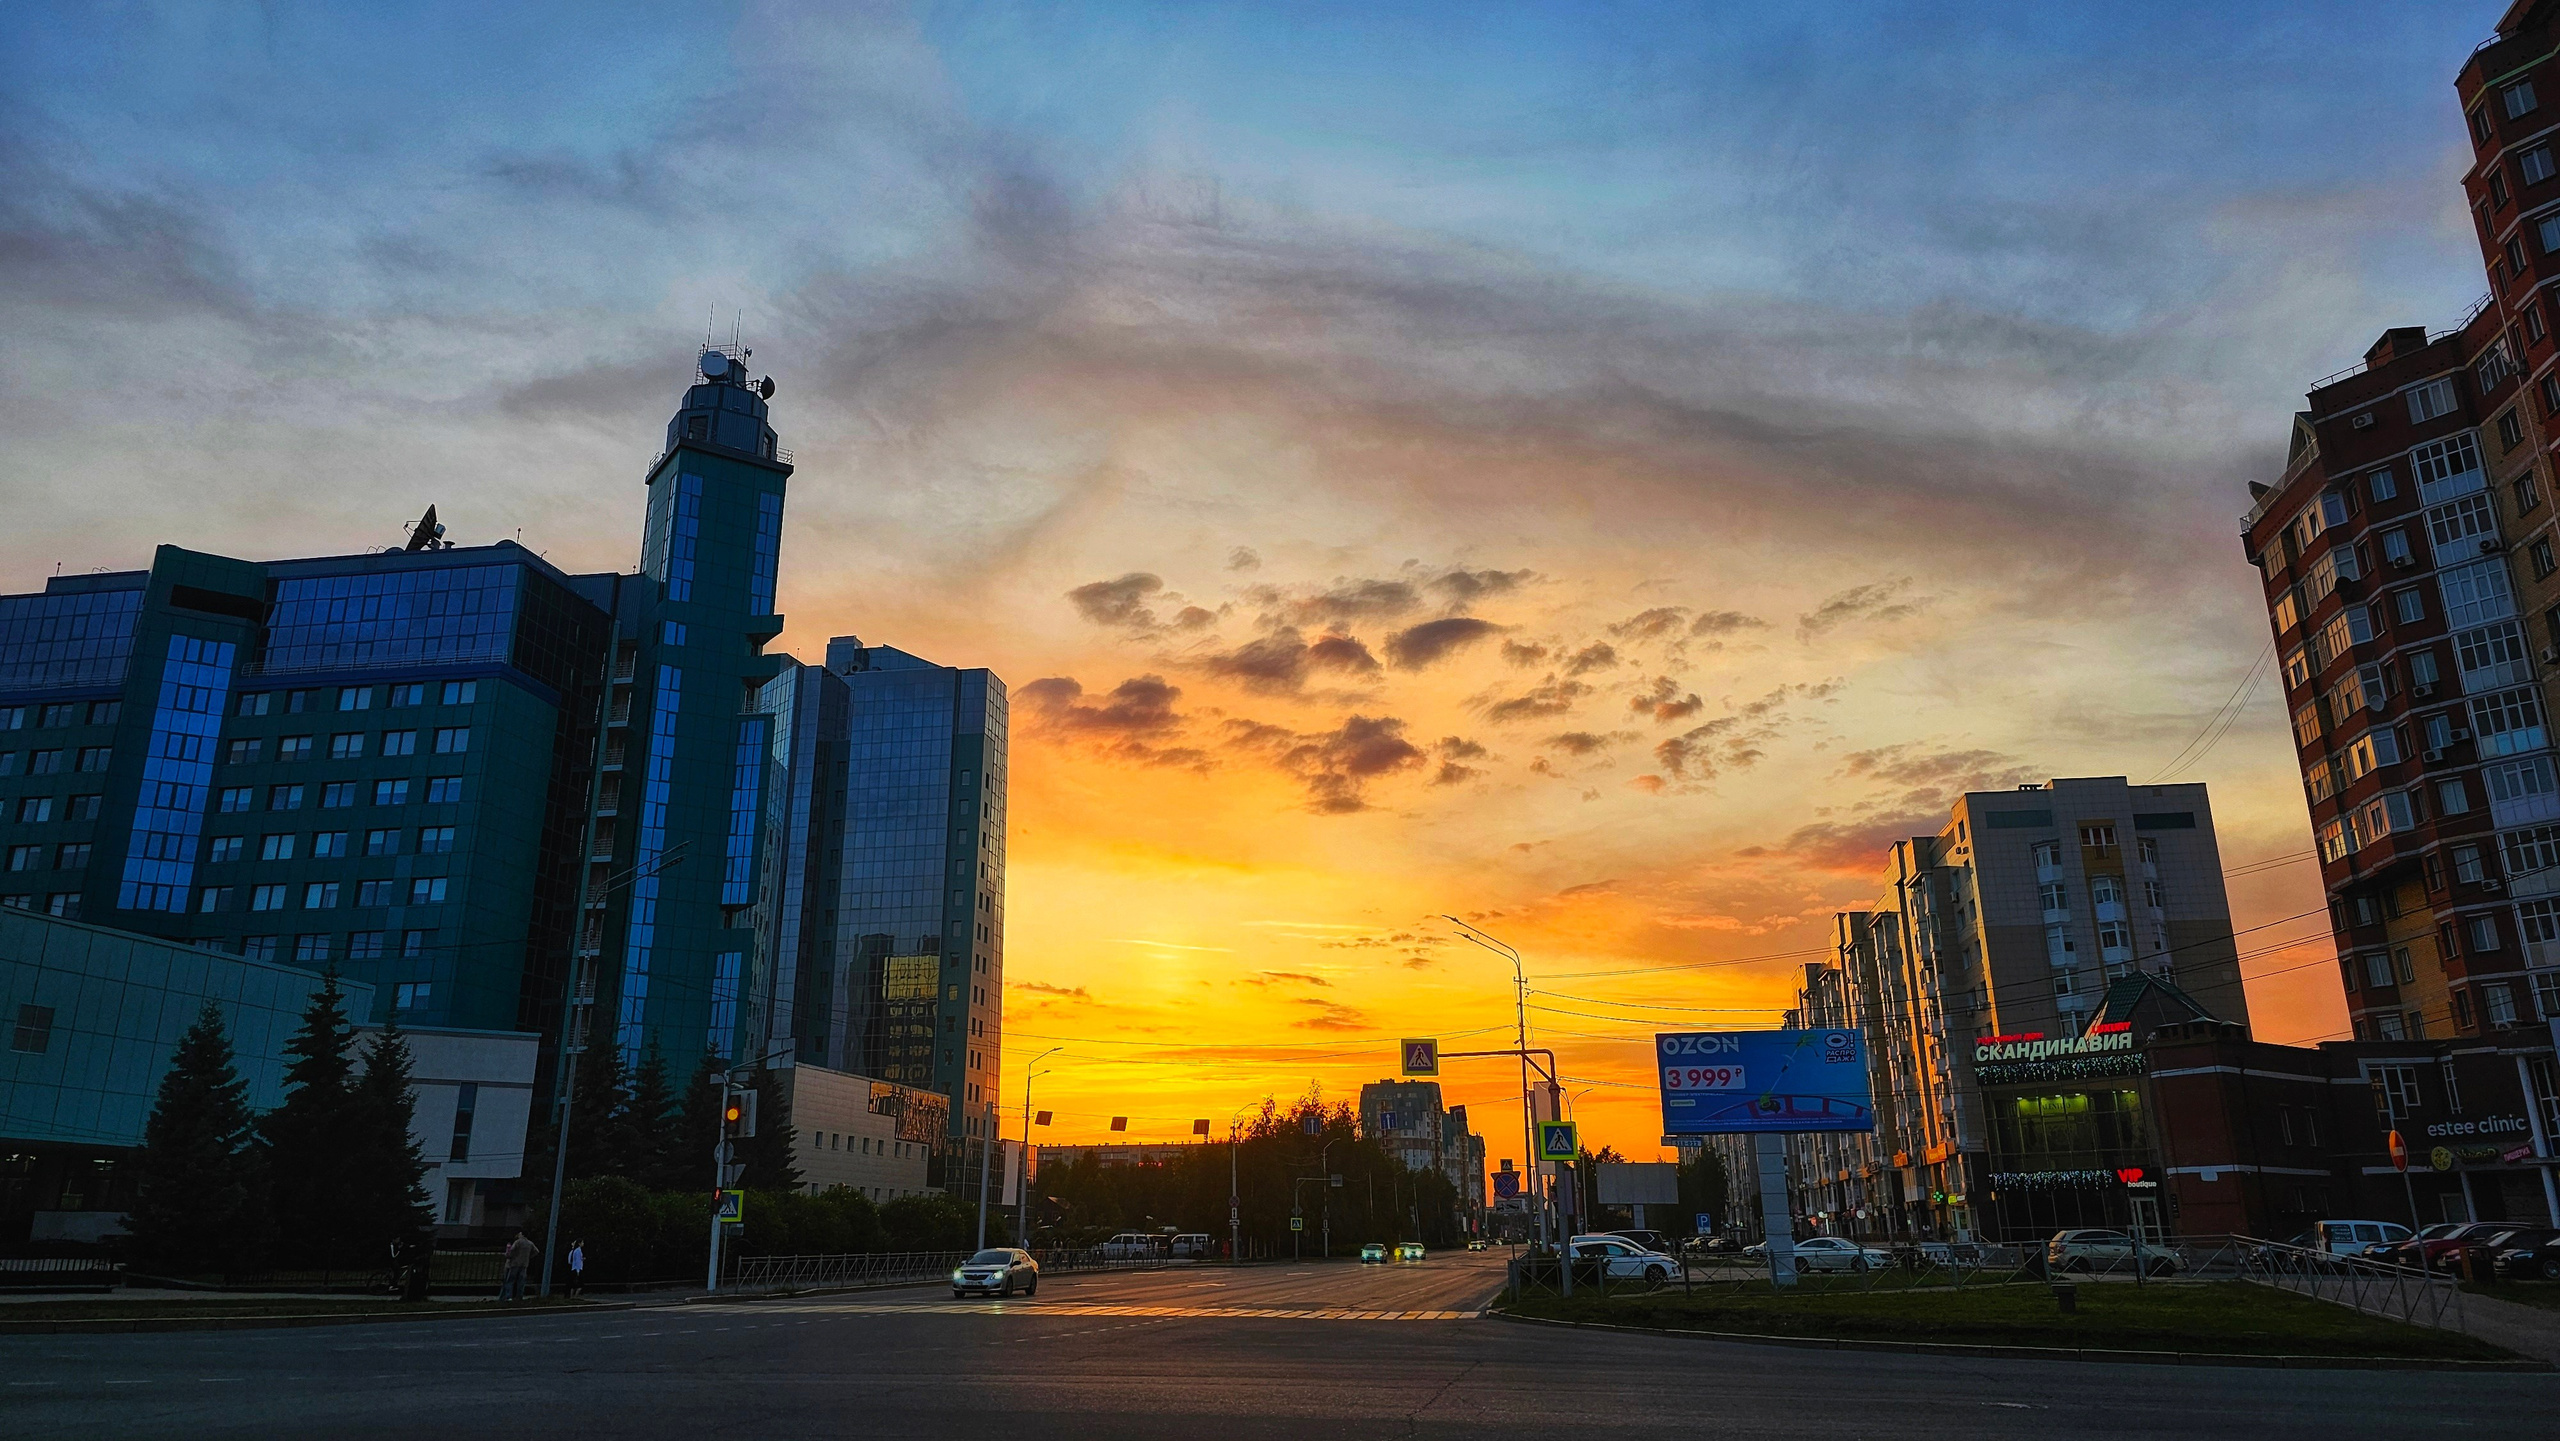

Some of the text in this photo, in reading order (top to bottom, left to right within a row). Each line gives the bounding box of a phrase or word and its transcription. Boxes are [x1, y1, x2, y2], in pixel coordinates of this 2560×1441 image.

[1662, 1036, 1739, 1055] OZON
[1975, 1032, 2132, 1062] СКАНДИНАВИЯ
[1668, 1070, 1681, 1088] 3
[1687, 1068, 1731, 1087] 999
[2427, 1113, 2527, 1137] estee clinic
[2117, 1168, 2143, 1183] VIP
[2127, 1180, 2157, 1189] boutique
